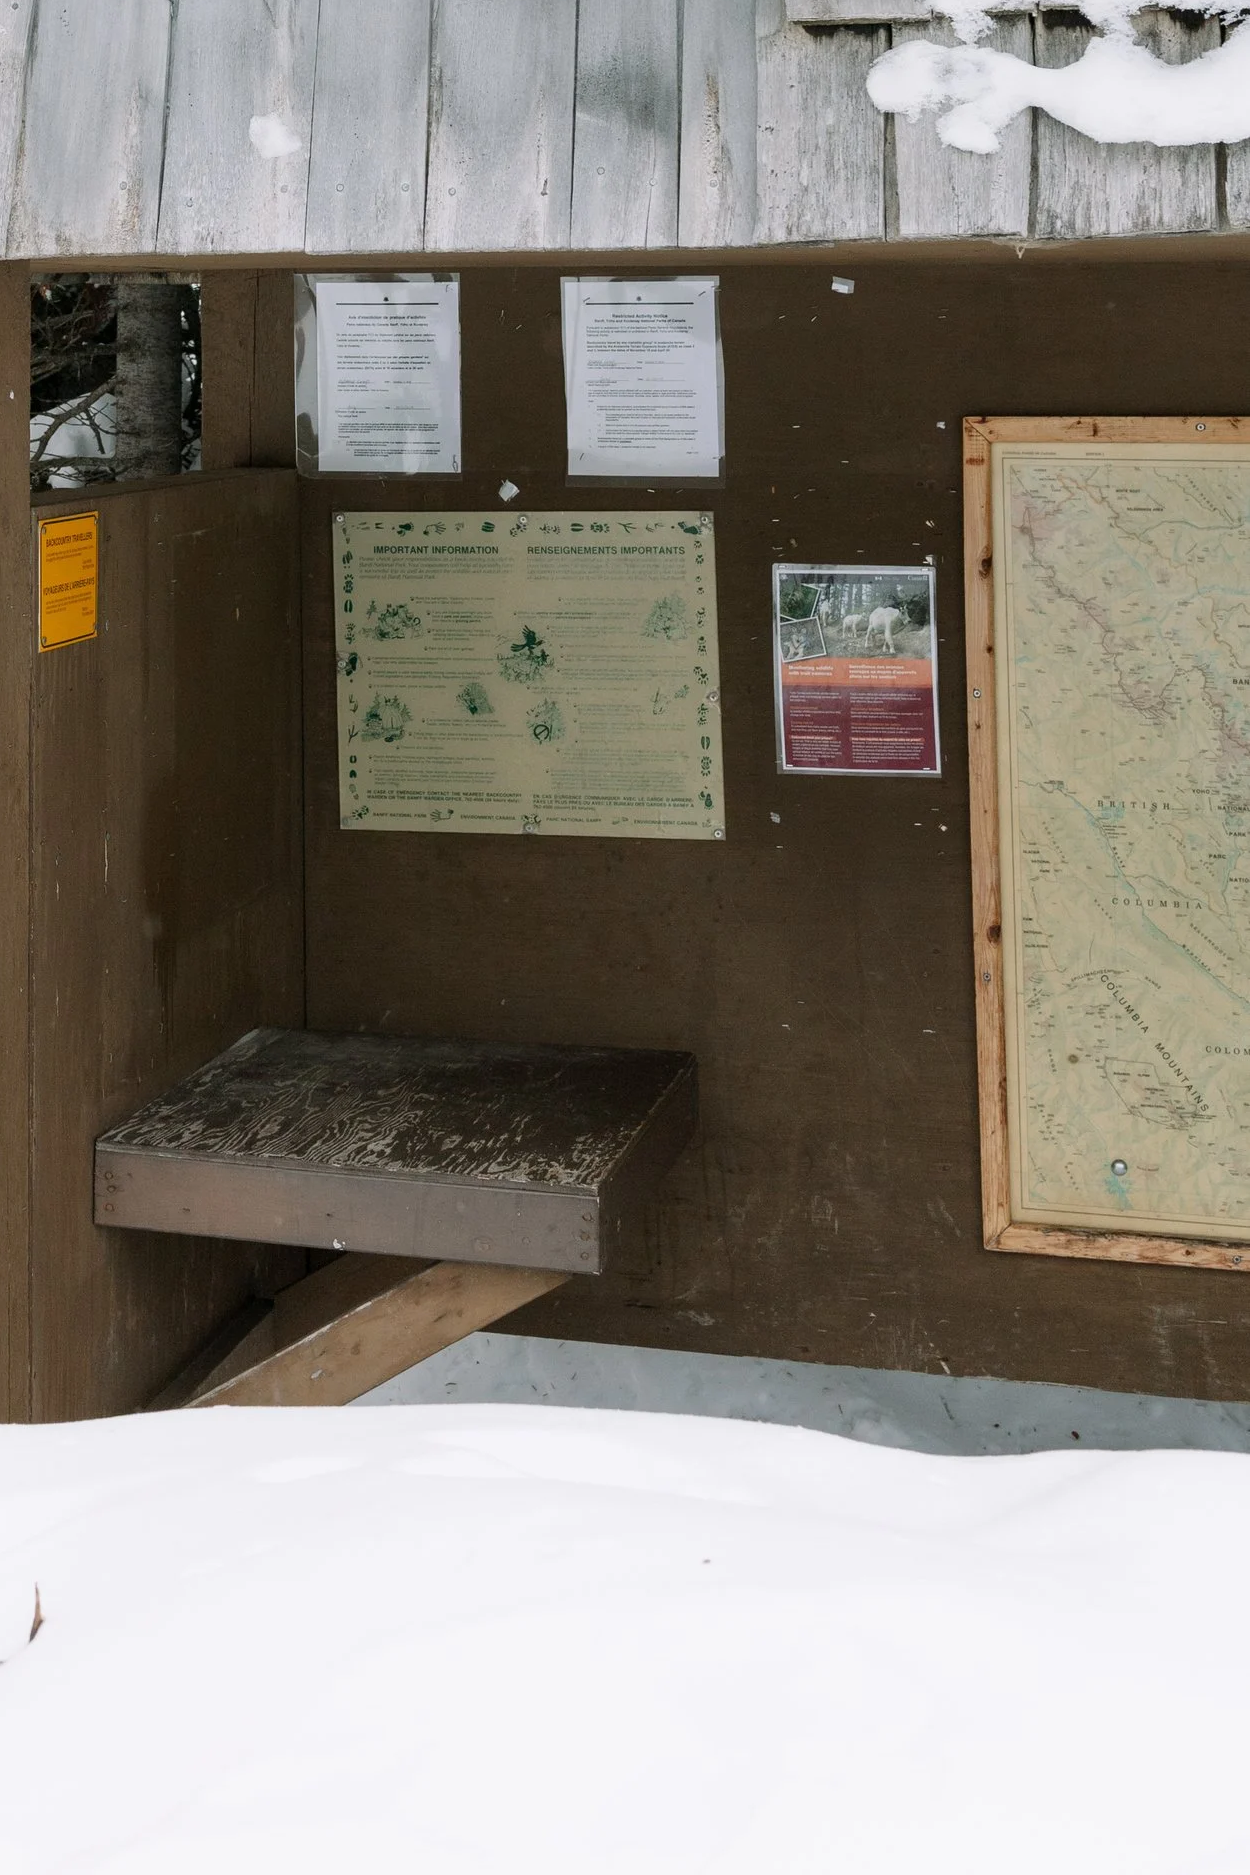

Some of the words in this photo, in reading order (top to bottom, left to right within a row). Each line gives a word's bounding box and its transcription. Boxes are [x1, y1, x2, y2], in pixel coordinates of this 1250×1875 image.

[373, 546, 429, 555] IMPORTANT
[432, 546, 499, 555] INFORMATION
[527, 546, 617, 555] RENSEIGNEMENTS
[621, 546, 686, 555] IMPORTANTS
[1097, 800, 1170, 810] BRITISH
[1111, 897, 1202, 910] COLUMBIA
[1100, 974, 1149, 1034] COLUMBIA
[1154, 1042, 1209, 1112] MOUNTAINS
